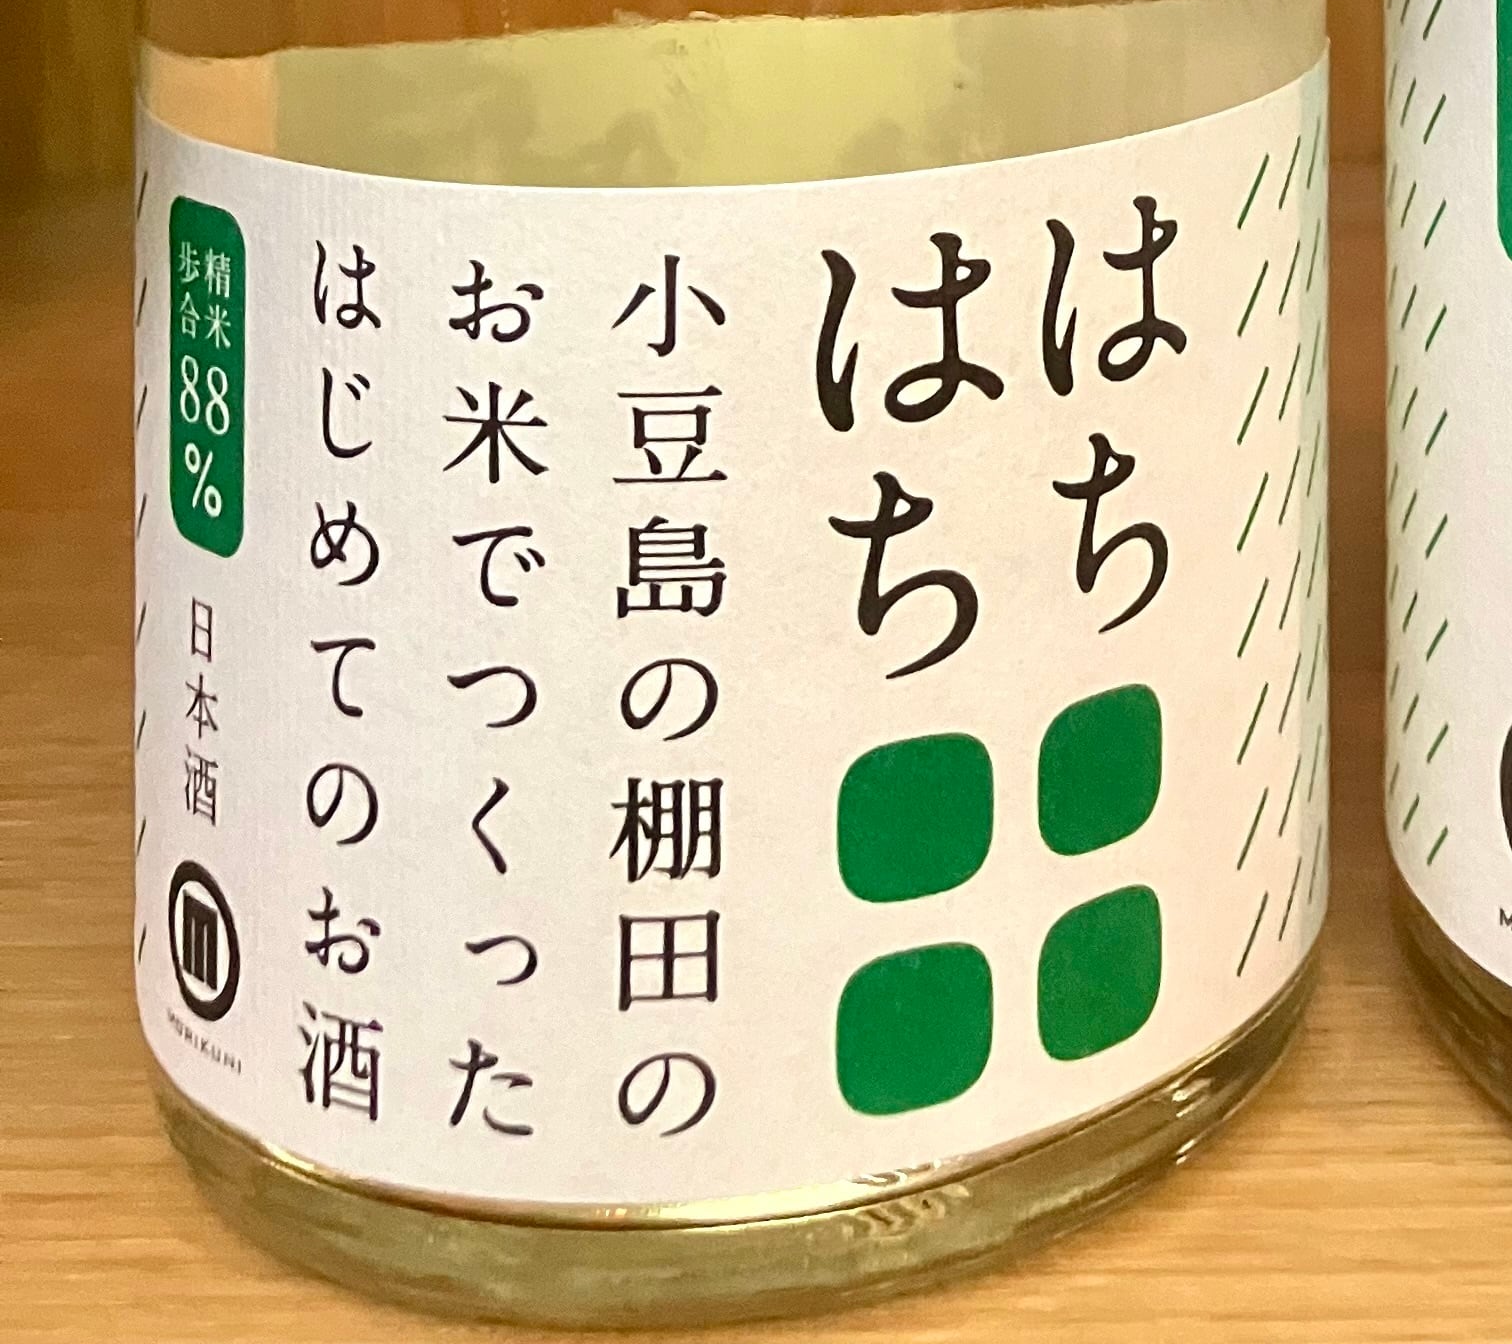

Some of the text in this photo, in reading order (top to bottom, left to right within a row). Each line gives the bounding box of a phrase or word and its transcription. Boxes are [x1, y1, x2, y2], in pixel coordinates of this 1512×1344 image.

[816, 232, 1004, 680] はち
[1043, 196, 1187, 633] はち
[184, 597, 219, 826] 日本酒
[299, 240, 383, 1122] はじめてのお酒
[443, 259, 549, 1136] お米でつくった
[610, 255, 727, 1136] 小豆島の棚田の
[168, 1008, 242, 1075] MORIKUNI
